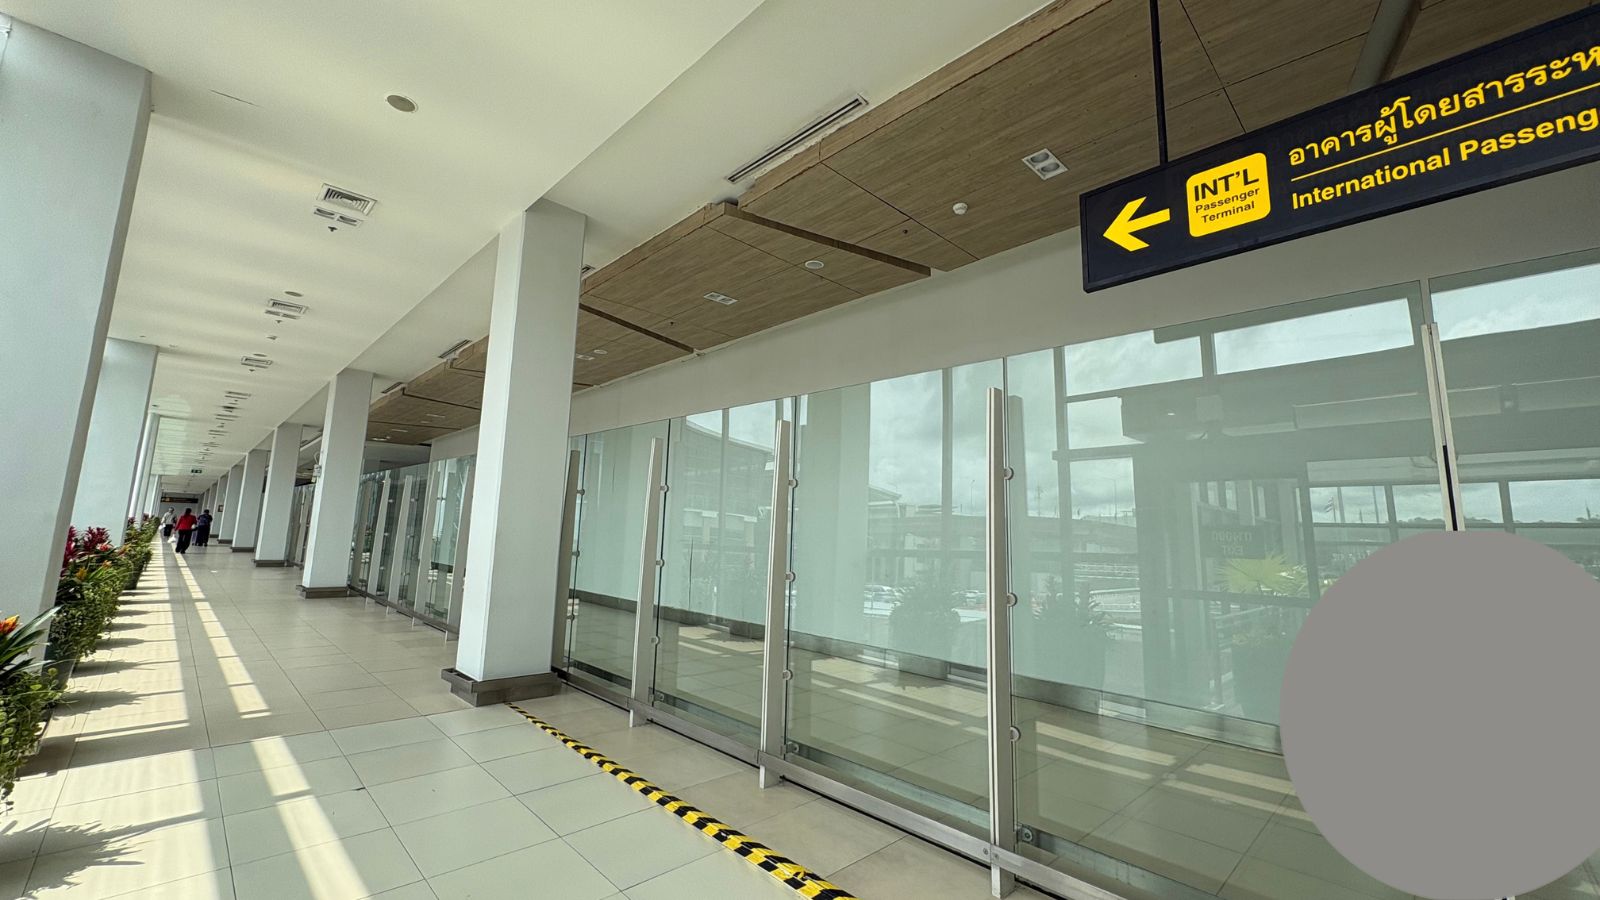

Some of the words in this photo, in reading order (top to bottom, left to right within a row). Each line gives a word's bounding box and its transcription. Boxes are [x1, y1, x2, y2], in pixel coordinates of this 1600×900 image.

[1288, 45, 1600, 166] อาคารผู้โดยสารระห
[1292, 147, 1451, 209] International
[1459, 107, 1600, 161] Passeng
[1194, 168, 1260, 202] INT'L
[1195, 188, 1260, 213] Passenger
[1202, 200, 1255, 223] Terminal
